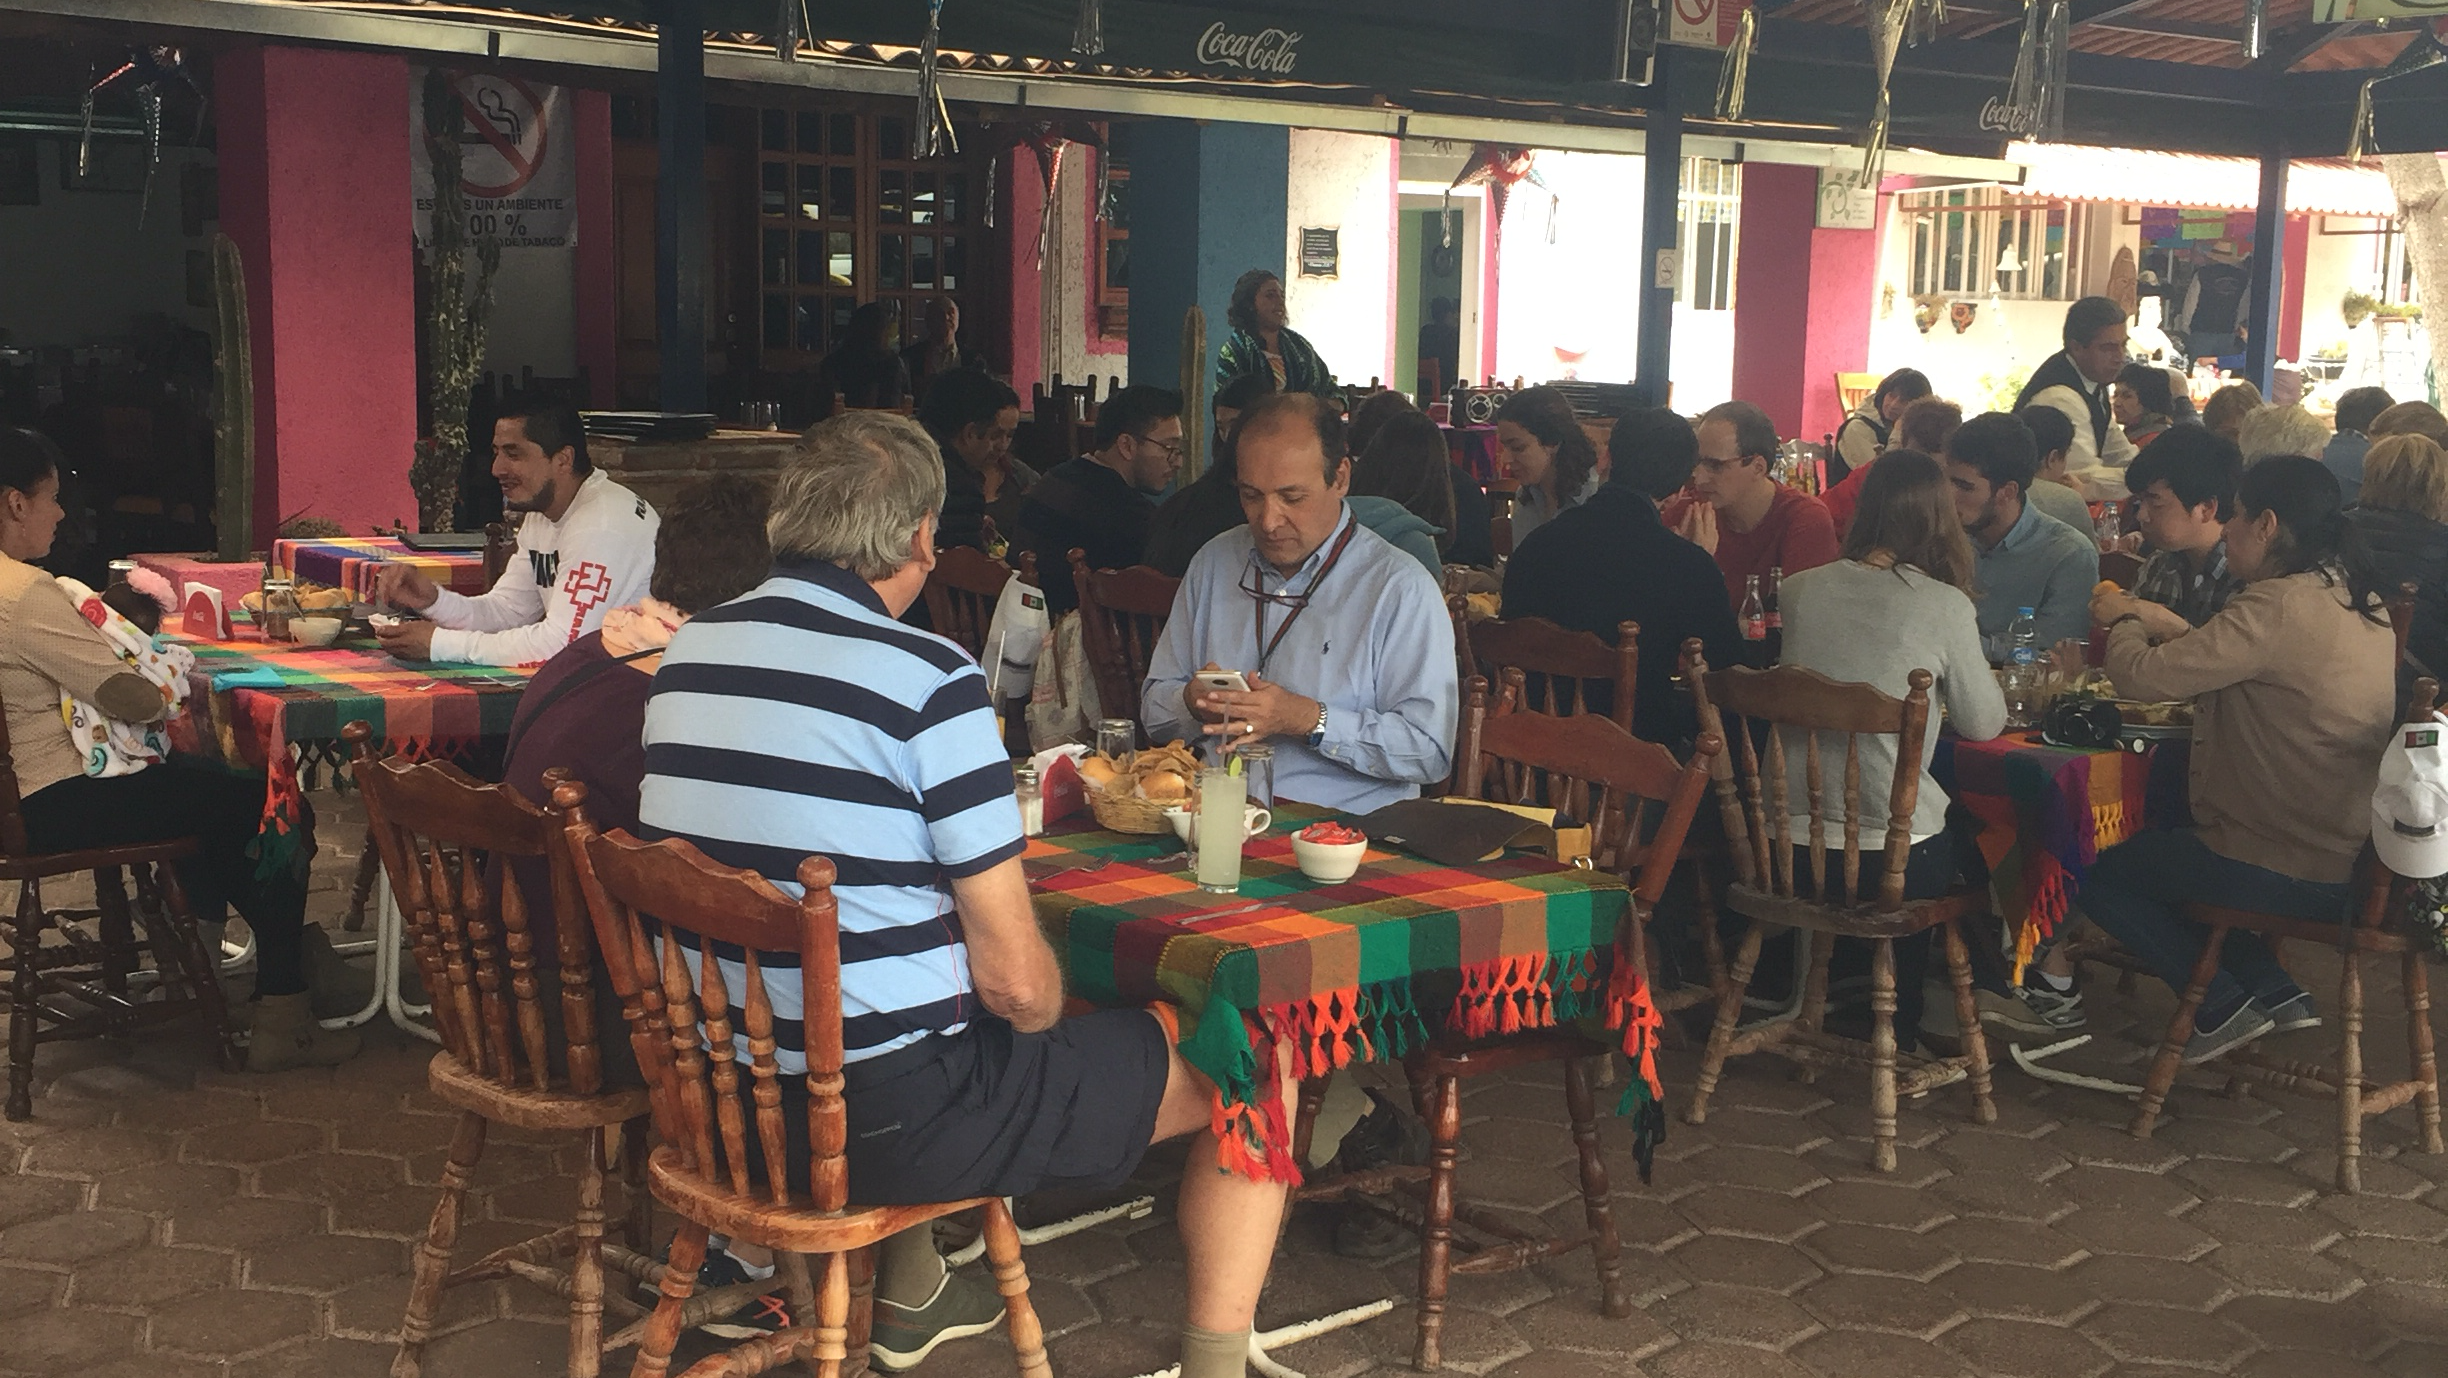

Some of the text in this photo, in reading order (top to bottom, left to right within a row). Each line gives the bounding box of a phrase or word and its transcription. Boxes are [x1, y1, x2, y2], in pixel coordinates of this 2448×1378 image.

[475, 199, 494, 211] UN
[497, 198, 564, 211] AMBIENTE
[469, 213, 527, 237] 00 %
[505, 237, 519, 248] DE
[521, 236, 566, 248] TABACO
